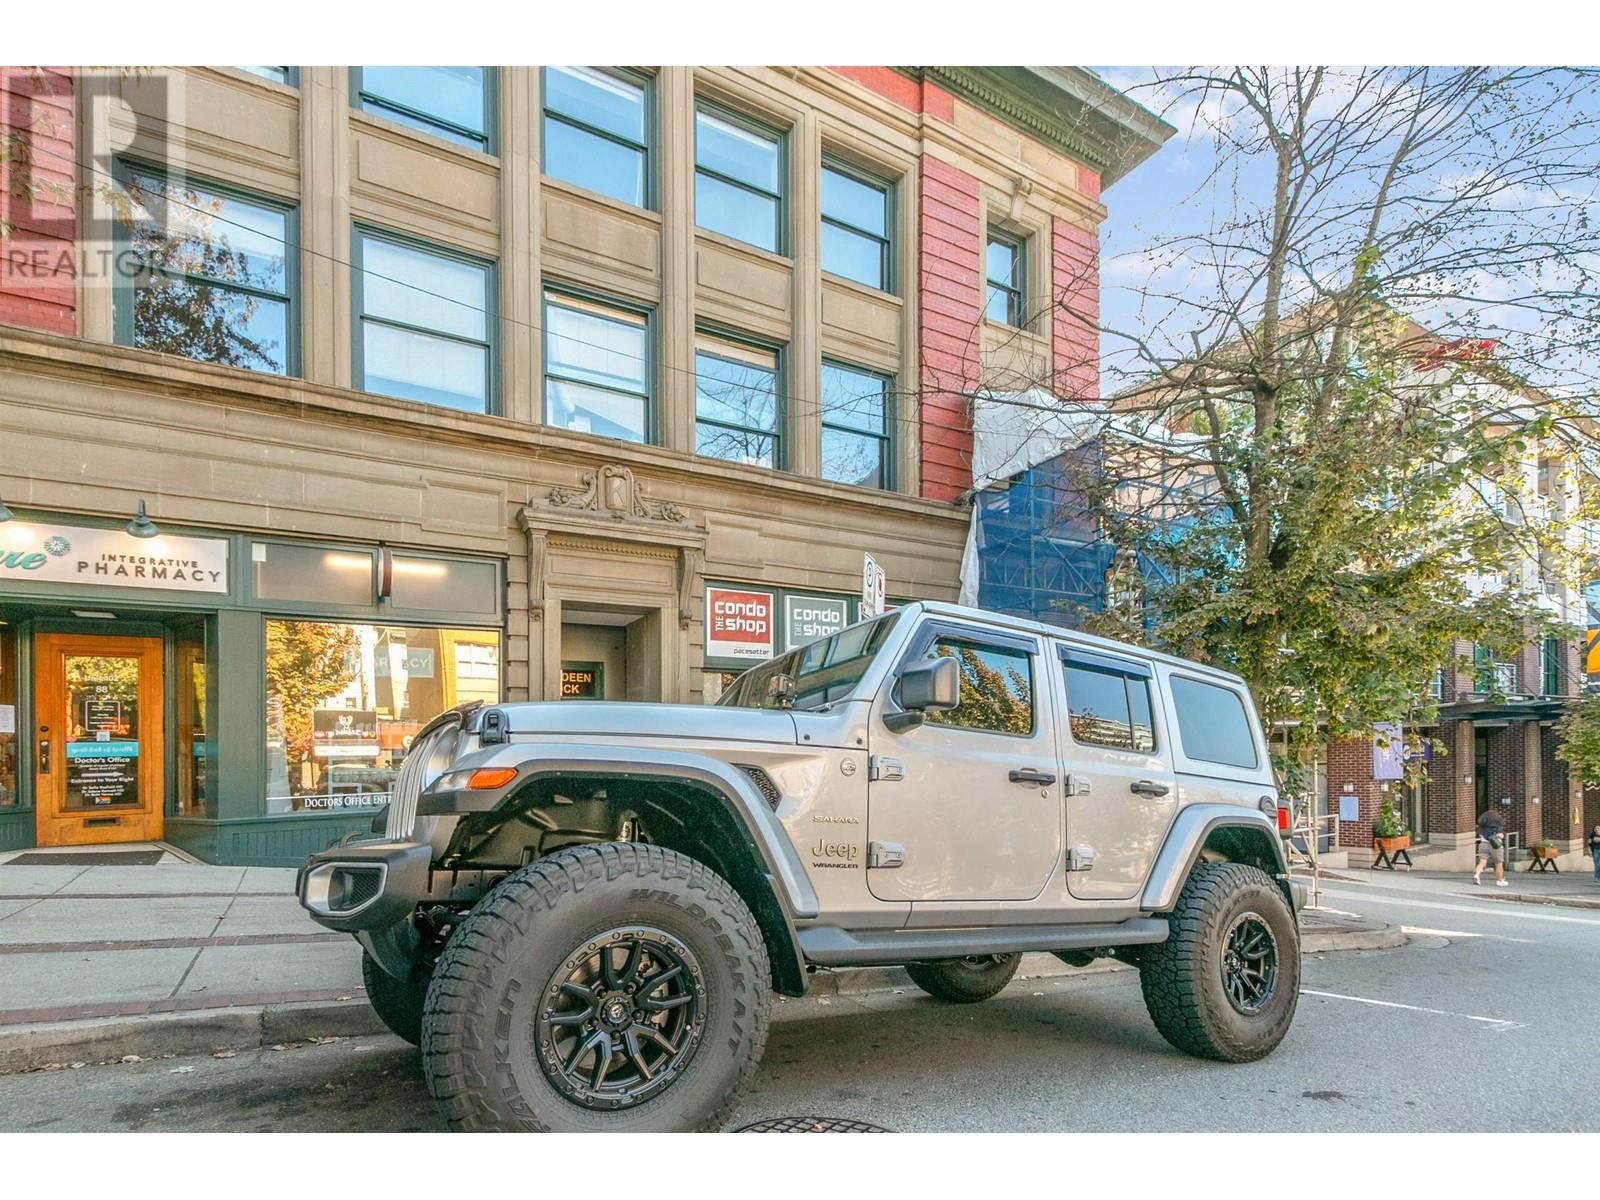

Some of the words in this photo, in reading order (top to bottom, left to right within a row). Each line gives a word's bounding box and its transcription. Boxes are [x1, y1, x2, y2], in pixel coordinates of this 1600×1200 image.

[101, 553, 198, 568] INTEGRATIVE
[77, 561, 221, 583] PHARMACY
[715, 616, 724, 632] THE
[725, 616, 767, 636] shop
[794, 622, 802, 637] THE
[733, 648, 770, 656] pacesetter
[812, 815, 860, 825] SAHARA
[812, 838, 858, 861] Jeep
[812, 862, 859, 870] WRANGLER
